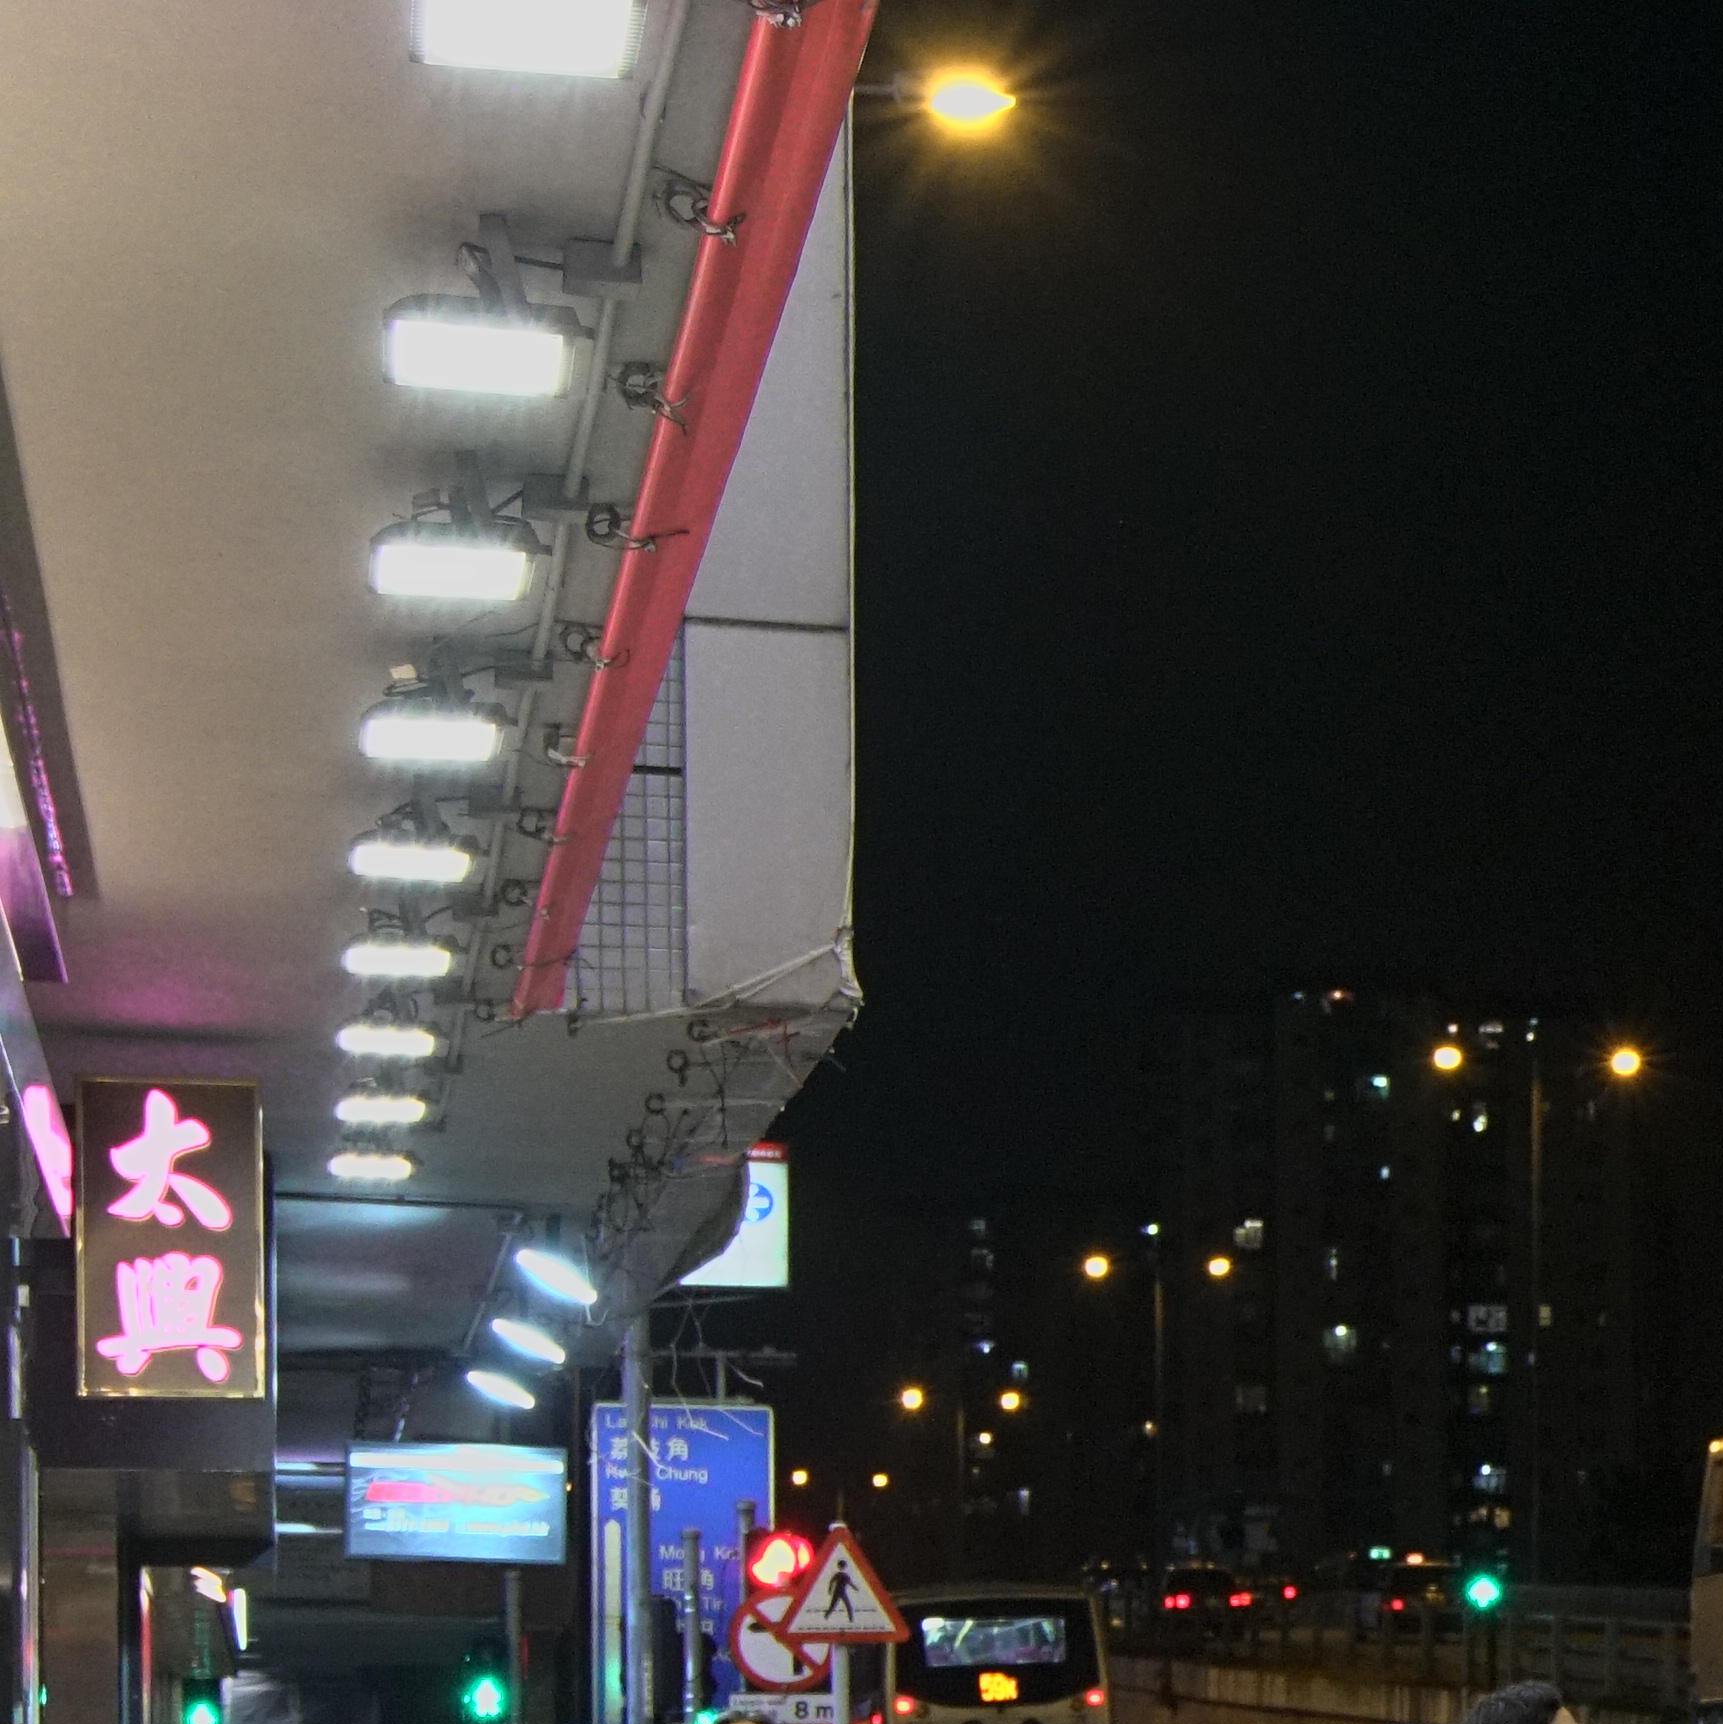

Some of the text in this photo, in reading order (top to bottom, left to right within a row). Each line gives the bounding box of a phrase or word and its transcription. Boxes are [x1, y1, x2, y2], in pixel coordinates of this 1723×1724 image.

[96, 1088, 243, 1383] 太興
[656, 1466, 708, 1485] Chung
[659, 1545, 705, 1563] Mog
[795, 1701, 809, 1719] 8
